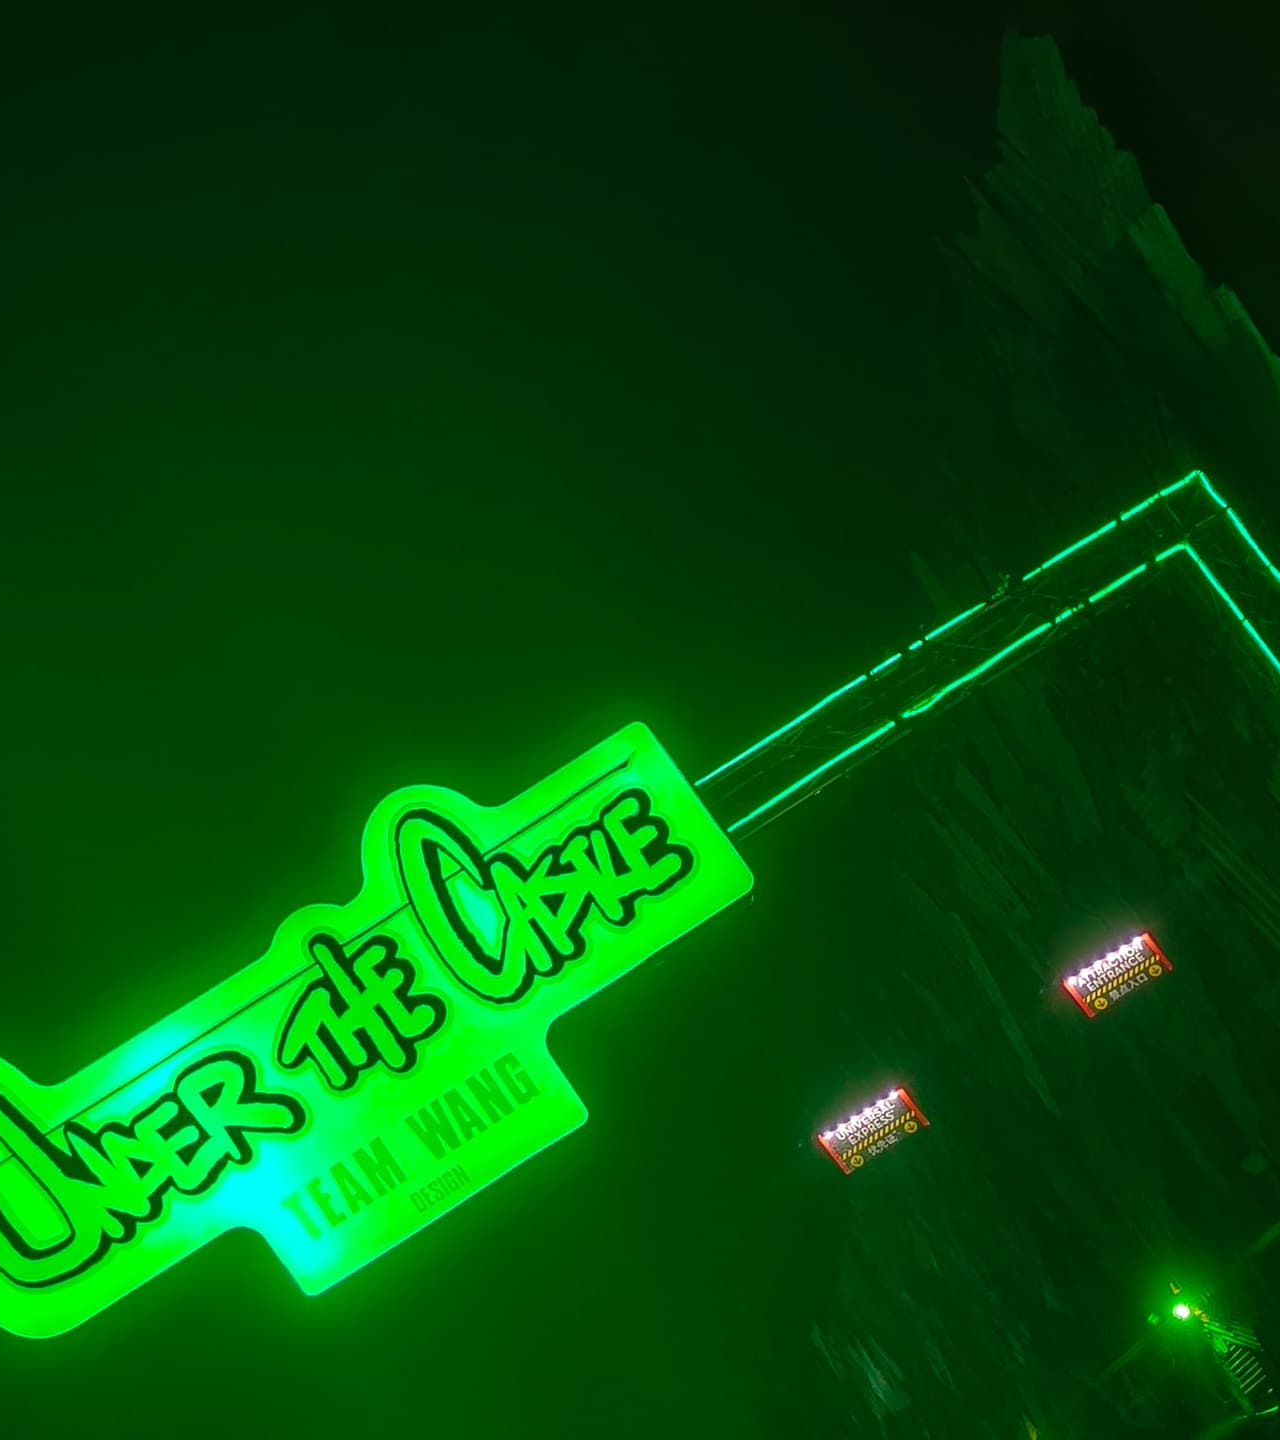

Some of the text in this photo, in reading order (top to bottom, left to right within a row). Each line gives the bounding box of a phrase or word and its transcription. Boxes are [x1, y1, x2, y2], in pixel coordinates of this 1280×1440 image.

[278, 933, 447, 1091] THE
[394, 788, 695, 1005] CASTLE
[1076, 942, 1144, 988] ATTRACTION
[1086, 953, 1145, 992] ENTRANCE
[835, 1101, 895, 1140] UNIVERSAL
[282, 1052, 541, 1240] TEAM WANG
[409, 1164, 471, 1213] DESIGN
